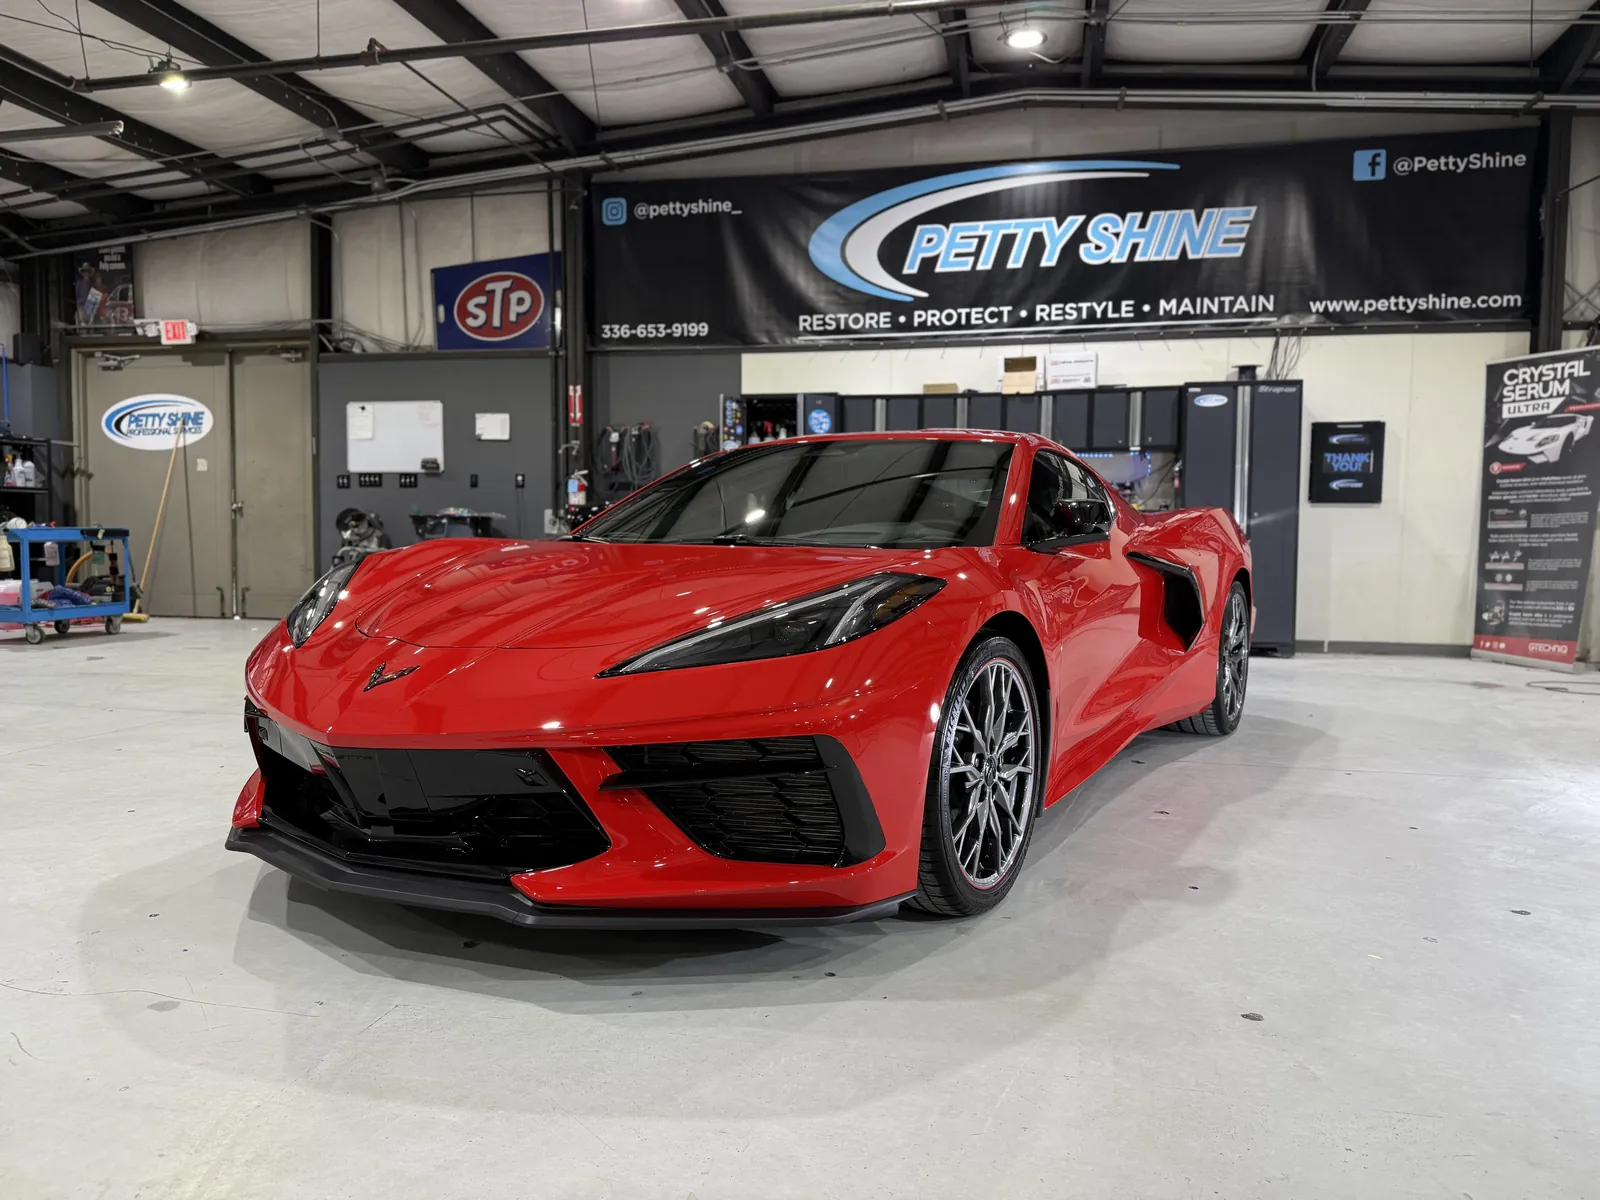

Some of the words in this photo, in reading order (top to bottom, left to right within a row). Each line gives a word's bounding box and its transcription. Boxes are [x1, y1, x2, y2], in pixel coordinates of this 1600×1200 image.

[1393, 151, 1527, 175] @PettyShine
[633, 198, 742, 219] @pettyshine_
[902, 214, 1087, 275] PETTY
[1079, 205, 1257, 266] SHINE
[465, 279, 532, 329] STP
[799, 312, 892, 331] RESTORE
[913, 306, 1012, 328] PROTECT
[1035, 300, 1135, 322] RESTYLE
[1158, 294, 1275, 316] MAINTAIN
[1309, 293, 1522, 315] www.pettyshine.com
[164, 321, 186, 341] EXIT
[601, 322, 709, 339] 336-653-9199
[1503, 359, 1591, 386] CRYSTAL
[1502, 379, 1570, 402] SERUM
[1507, 401, 1550, 415] ULTRA
[128, 412, 166, 428] PETTY
[167, 411, 205, 427] SHINE
[127, 428, 172, 436] PROFESSIONAL
[173, 426, 203, 435] SRVICES
[1324, 452, 1370, 463] THANK
[1332, 461, 1363, 472] YOU!
